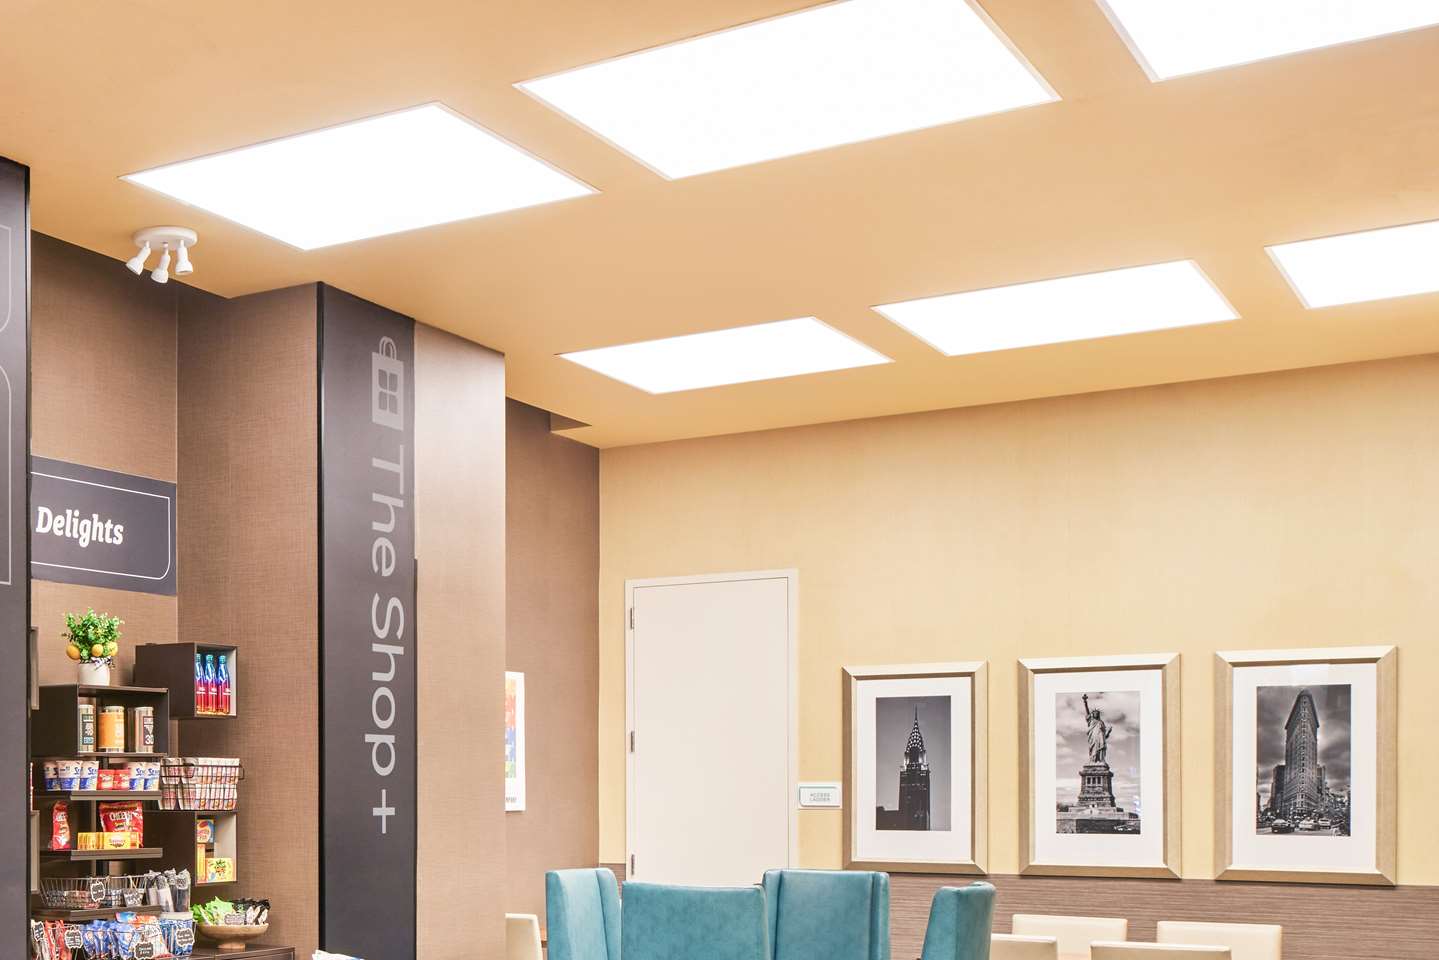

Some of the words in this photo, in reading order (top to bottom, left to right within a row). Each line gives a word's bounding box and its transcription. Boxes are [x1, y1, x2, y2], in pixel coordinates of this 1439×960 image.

[35, 506, 124, 548] Delights
[371, 445, 405, 577] The
[364, 592, 405, 777] Shop
